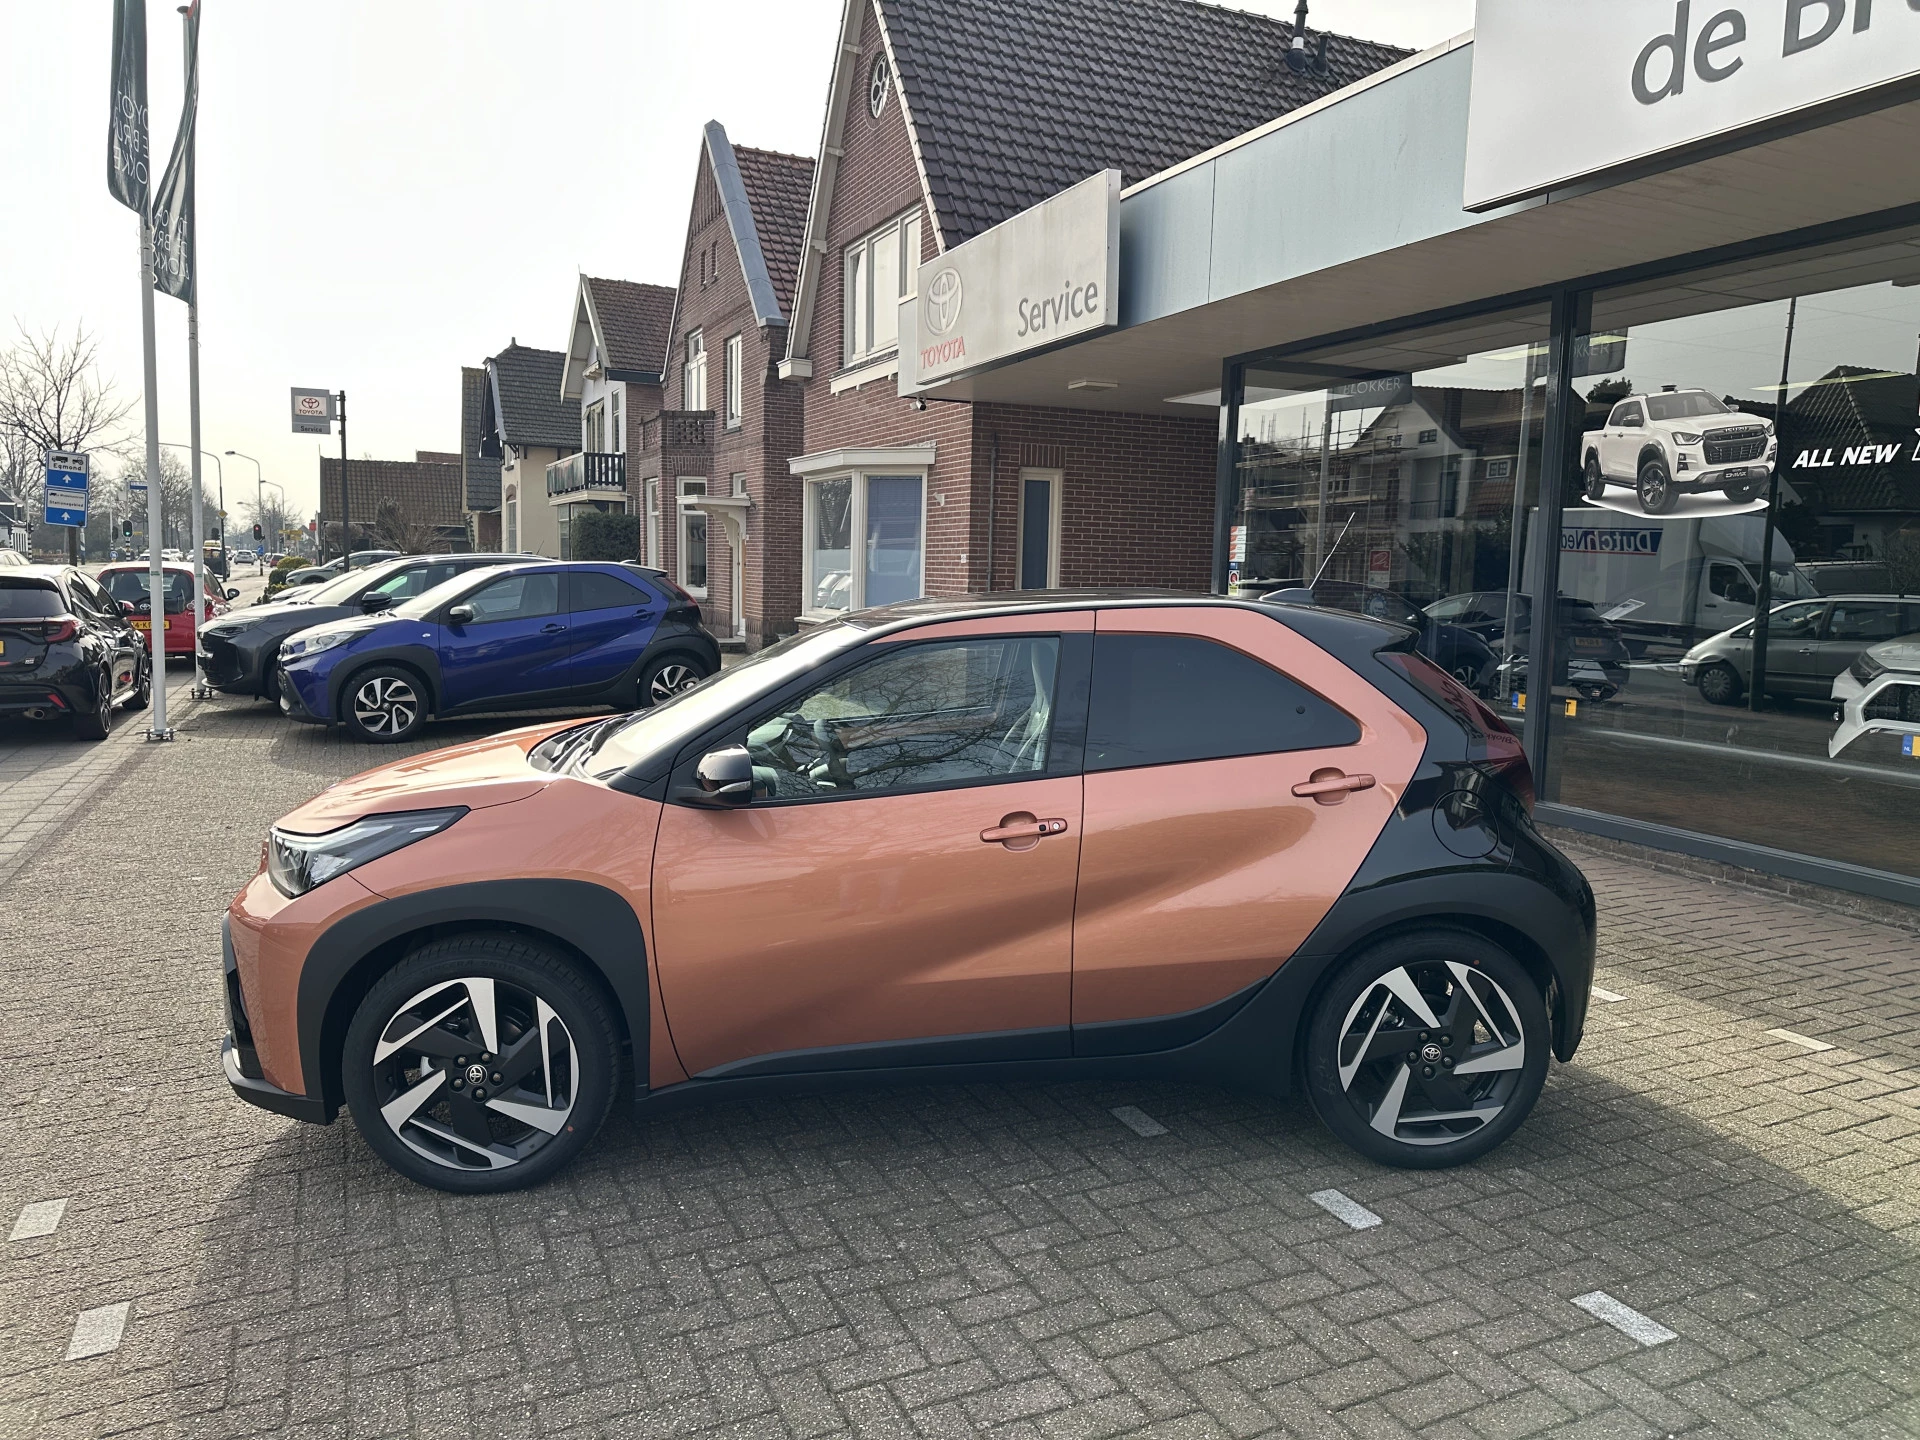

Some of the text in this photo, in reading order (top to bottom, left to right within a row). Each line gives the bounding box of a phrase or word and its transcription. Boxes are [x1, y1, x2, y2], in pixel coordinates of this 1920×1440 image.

[1631, 0, 1747, 105] de
[1017, 280, 1098, 337] Service
[920, 335, 966, 370] TOYOTA
[301, 425, 323, 433] Service
[53, 463, 82, 471] Egmond
[1792, 448, 1835, 469] ALL
[1840, 443, 1902, 465] NEW
